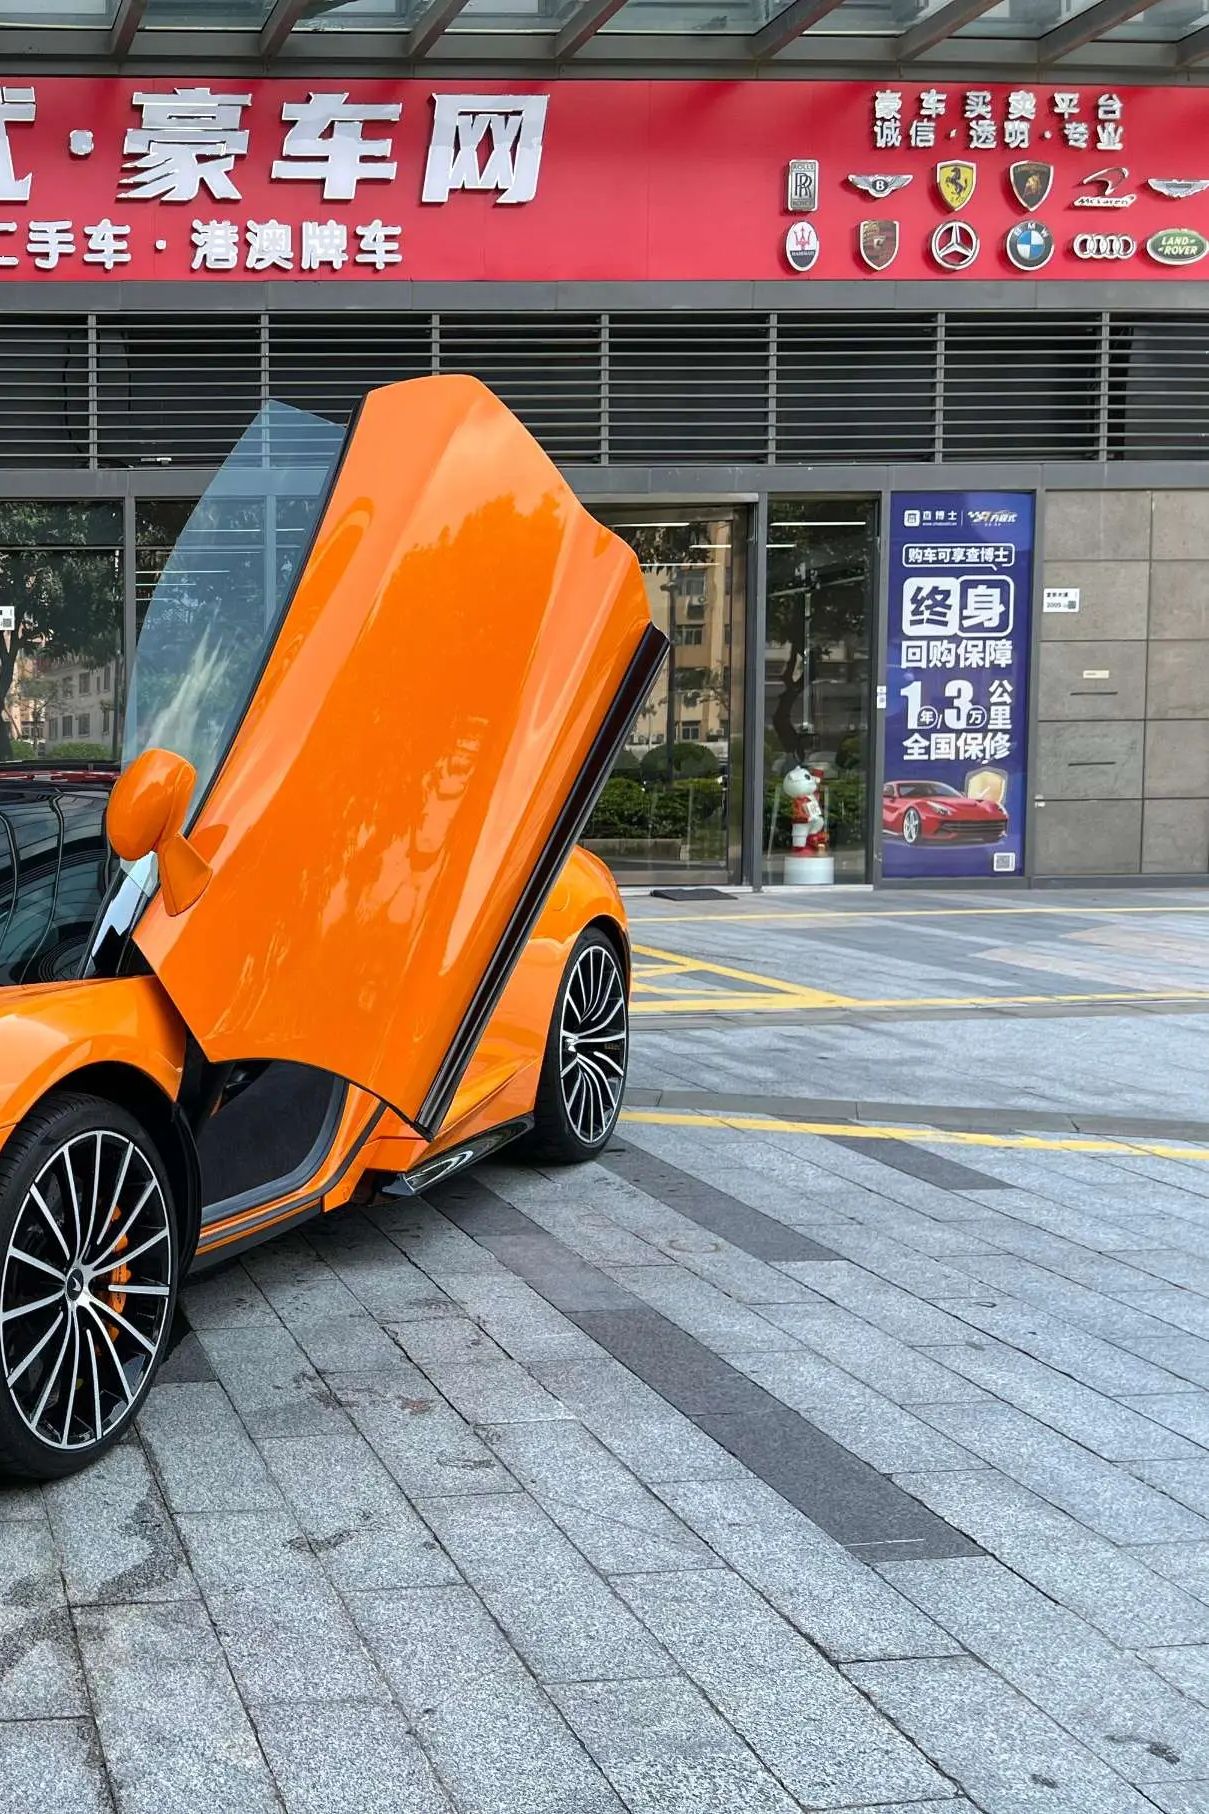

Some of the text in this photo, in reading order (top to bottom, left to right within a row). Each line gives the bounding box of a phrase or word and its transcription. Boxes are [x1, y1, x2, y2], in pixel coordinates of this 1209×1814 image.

[874, 89, 1123, 119] 豪车买卖平台
[874, 118, 1123, 150] 诚信·透明·专业
[1014, 222, 1049, 237] BMW
[1161, 236, 1190, 246] LAND
[1163, 245, 1199, 255] ROVER
[908, 547, 1009, 563] 购车可享查博士
[909, 584, 1006, 628] 终身
[900, 639, 1013, 668] 回购保障
[902, 732, 1012, 760] 全国保修
